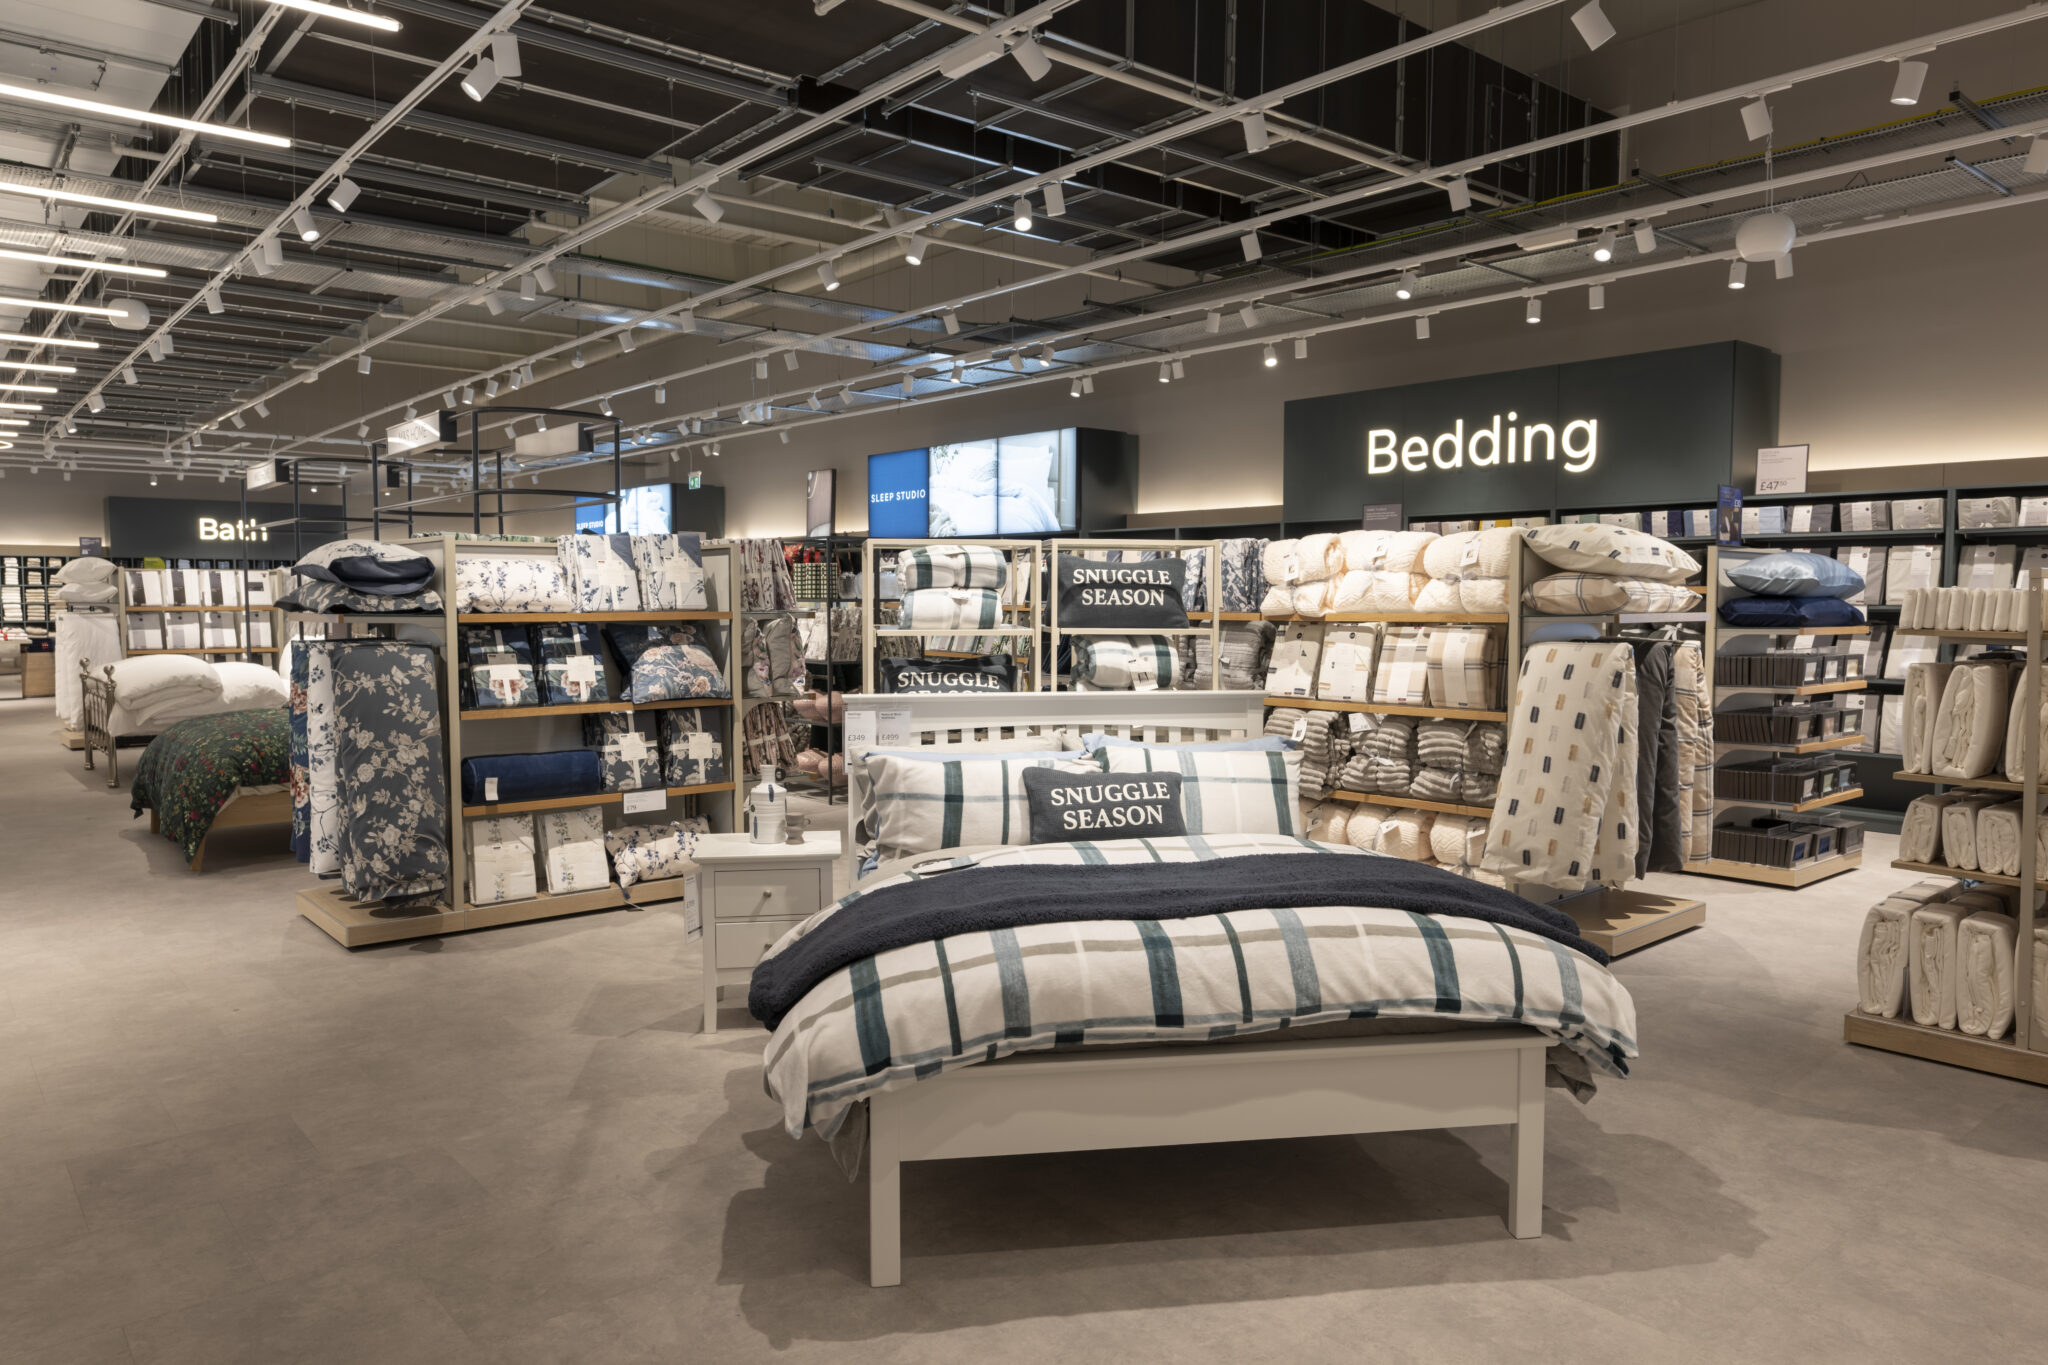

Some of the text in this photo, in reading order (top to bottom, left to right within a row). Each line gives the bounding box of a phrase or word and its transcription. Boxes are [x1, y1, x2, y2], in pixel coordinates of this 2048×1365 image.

[1367, 411, 1598, 475] Bedding
[871, 489, 926, 503] SLEEP STUDIO
[1072, 568, 1172, 586] SNUGGLE
[1081, 588, 1165, 606] SEASON
[897, 672, 1000, 690] SNUGGLE
[1050, 781, 1171, 806] SNUGGLE
[1063, 804, 1164, 831] SEASON
